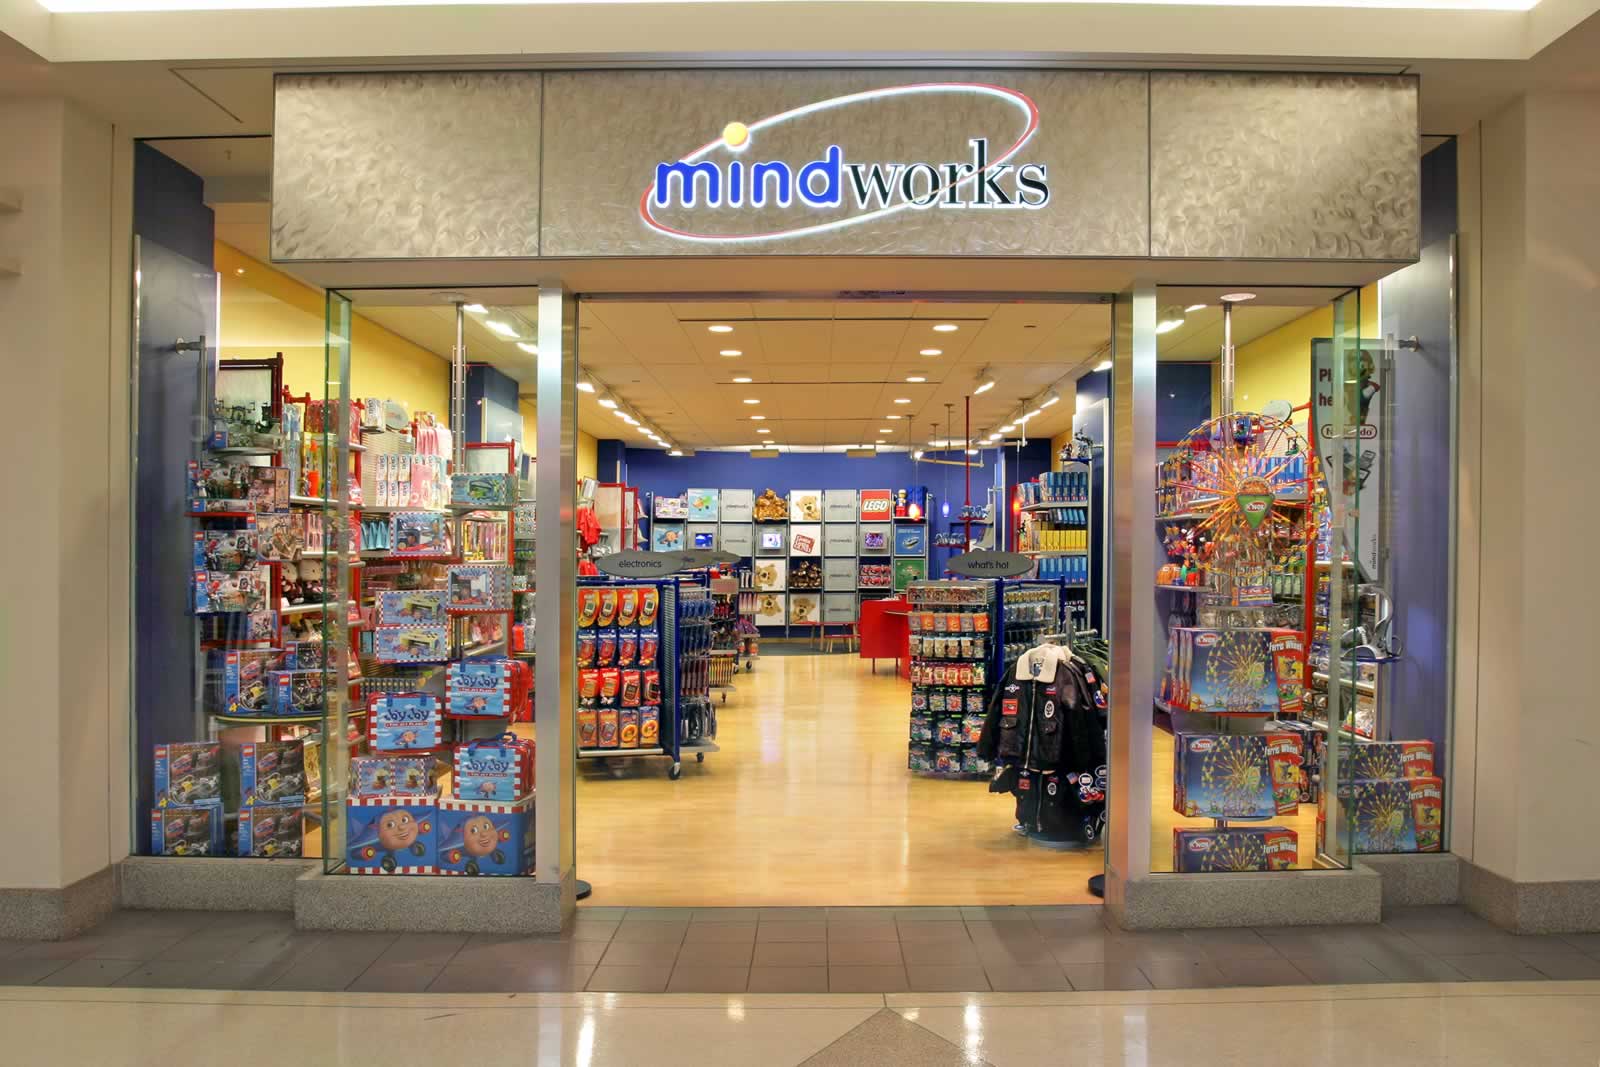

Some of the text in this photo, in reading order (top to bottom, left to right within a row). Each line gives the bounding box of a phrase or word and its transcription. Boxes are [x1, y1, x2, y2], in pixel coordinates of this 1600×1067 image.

[654, 140, 1050, 209] mindworks
[864, 499, 888, 511] LEGO
[618, 560, 662, 568] electronics
[967, 561, 994, 569] what's
